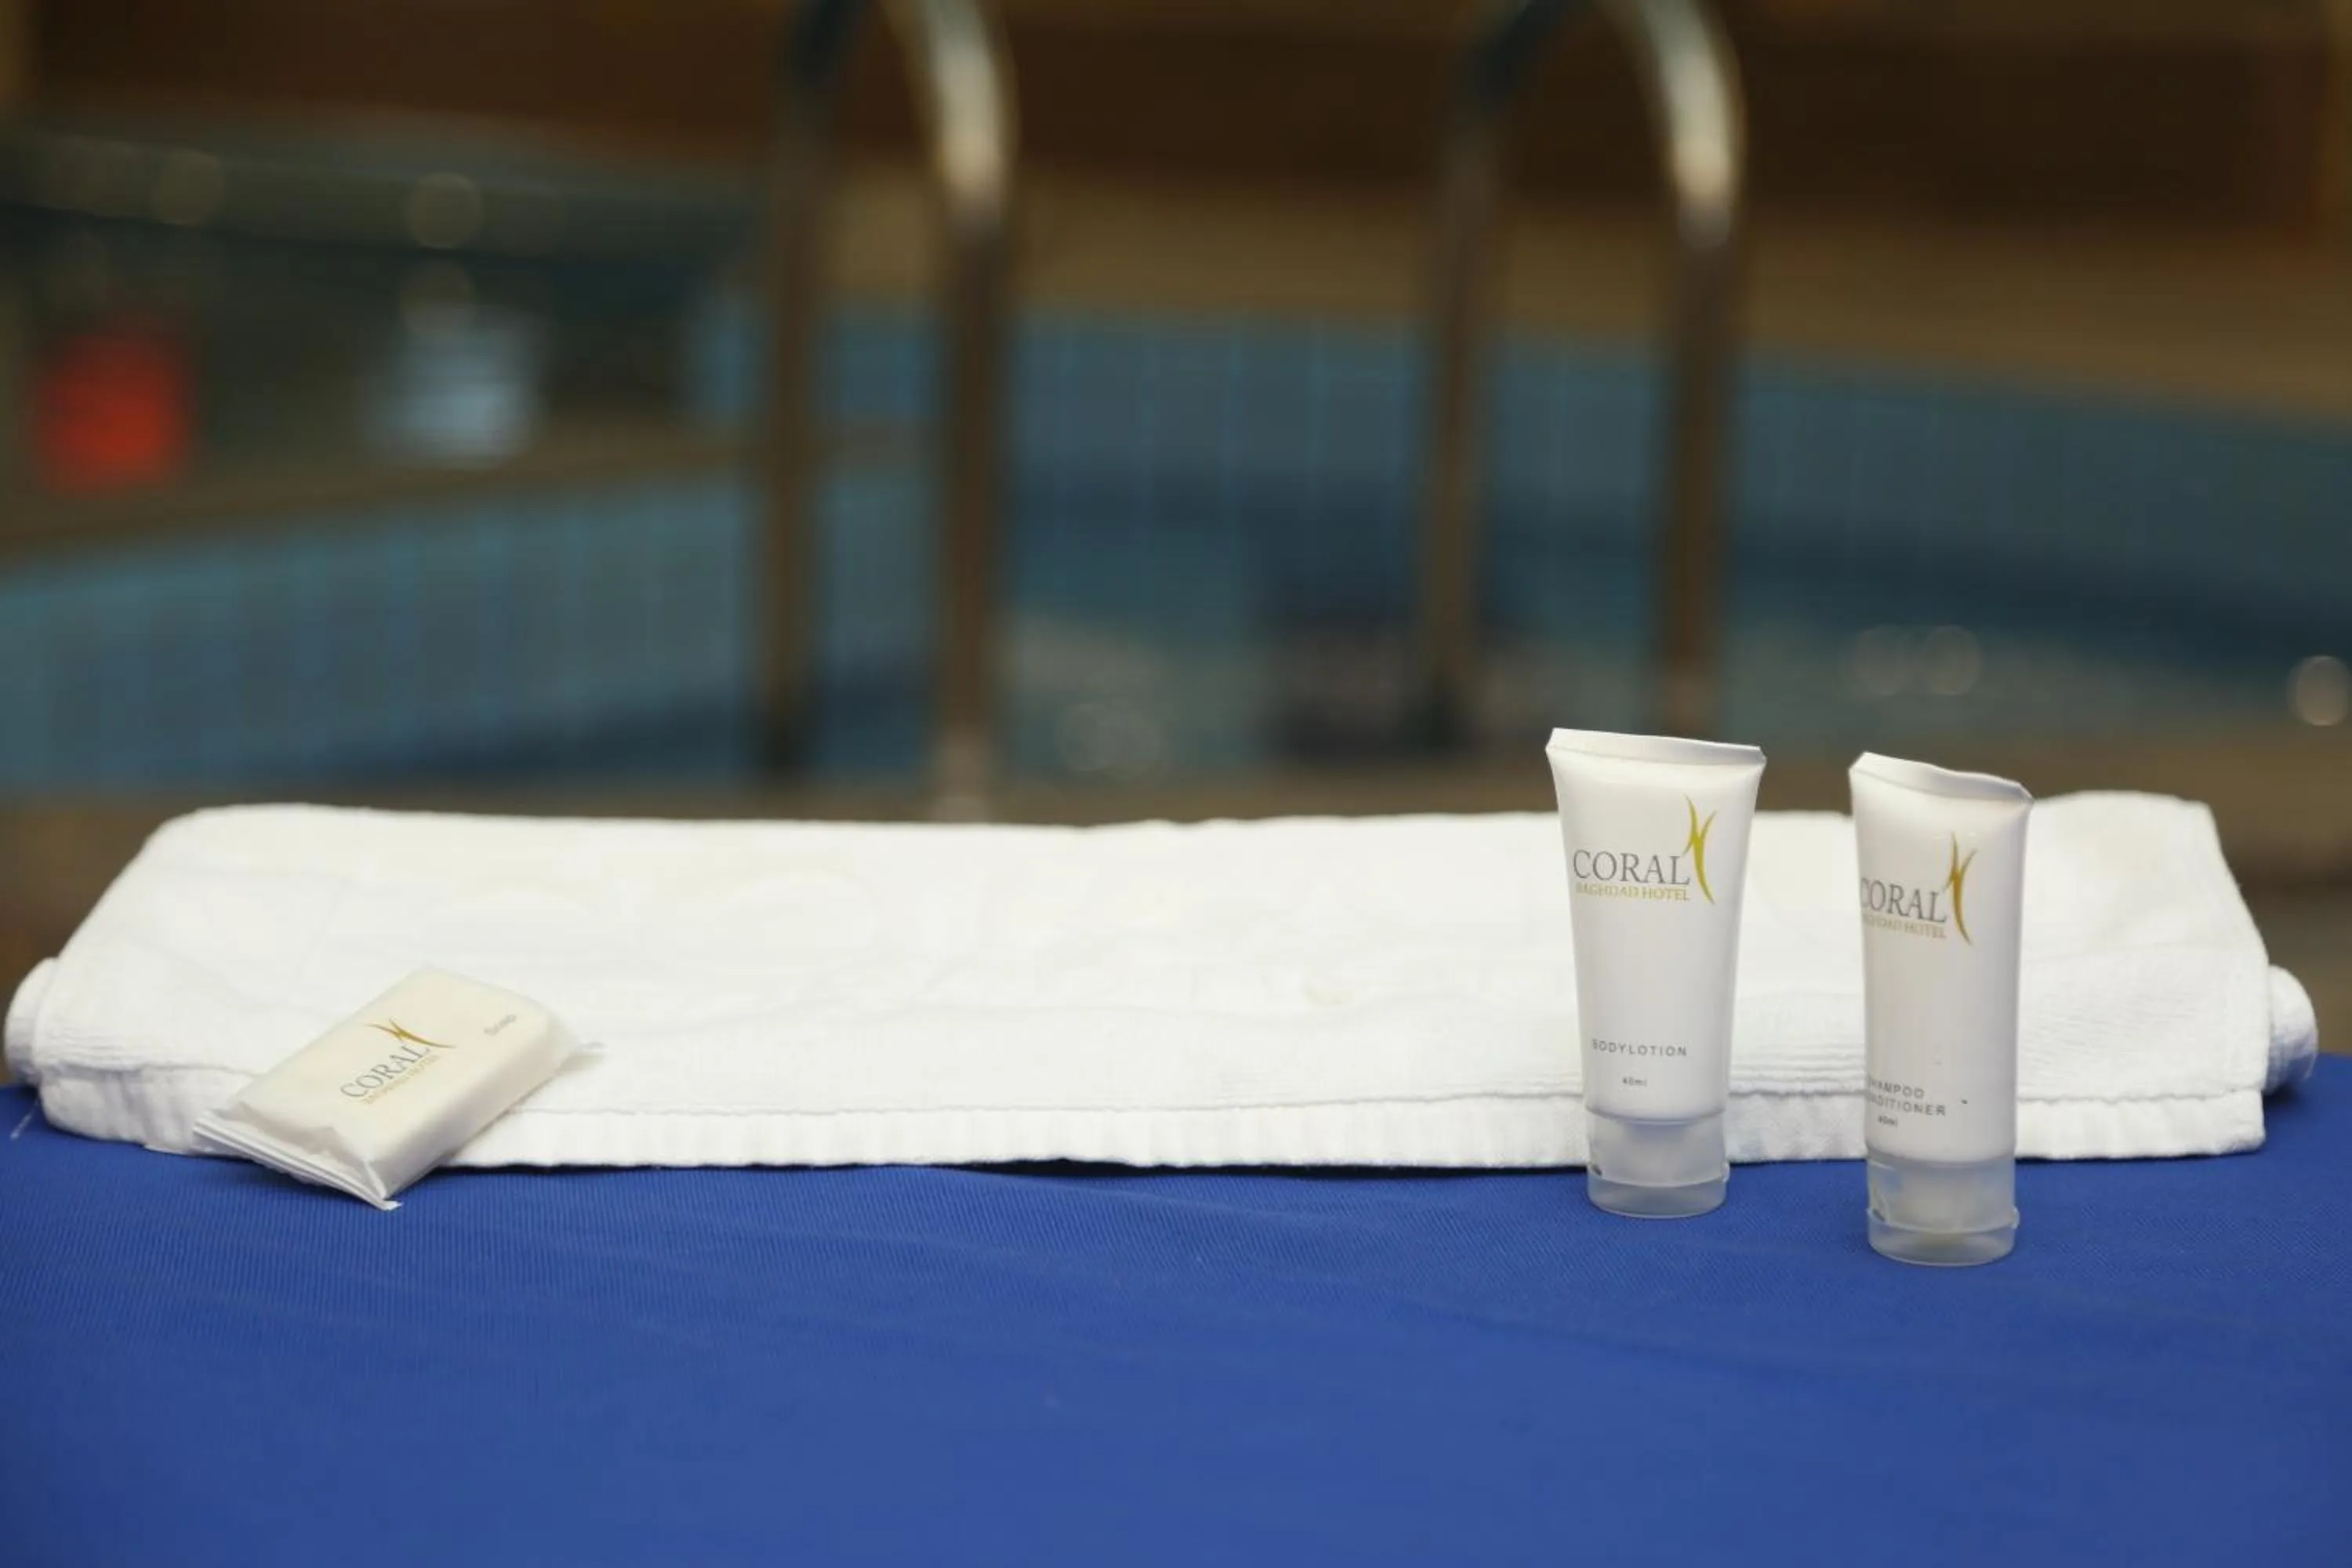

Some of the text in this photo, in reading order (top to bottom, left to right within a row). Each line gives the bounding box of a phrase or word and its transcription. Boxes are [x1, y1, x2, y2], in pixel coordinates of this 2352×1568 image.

[1573, 849, 1691, 885] CORAL
[1576, 881, 1691, 902] BAGHDAD HOTEL
[1592, 1038, 1687, 1057] BODYLOTION
[339, 1044, 431, 1098] CORAL
[1621, 1075, 1648, 1087] 40ml
